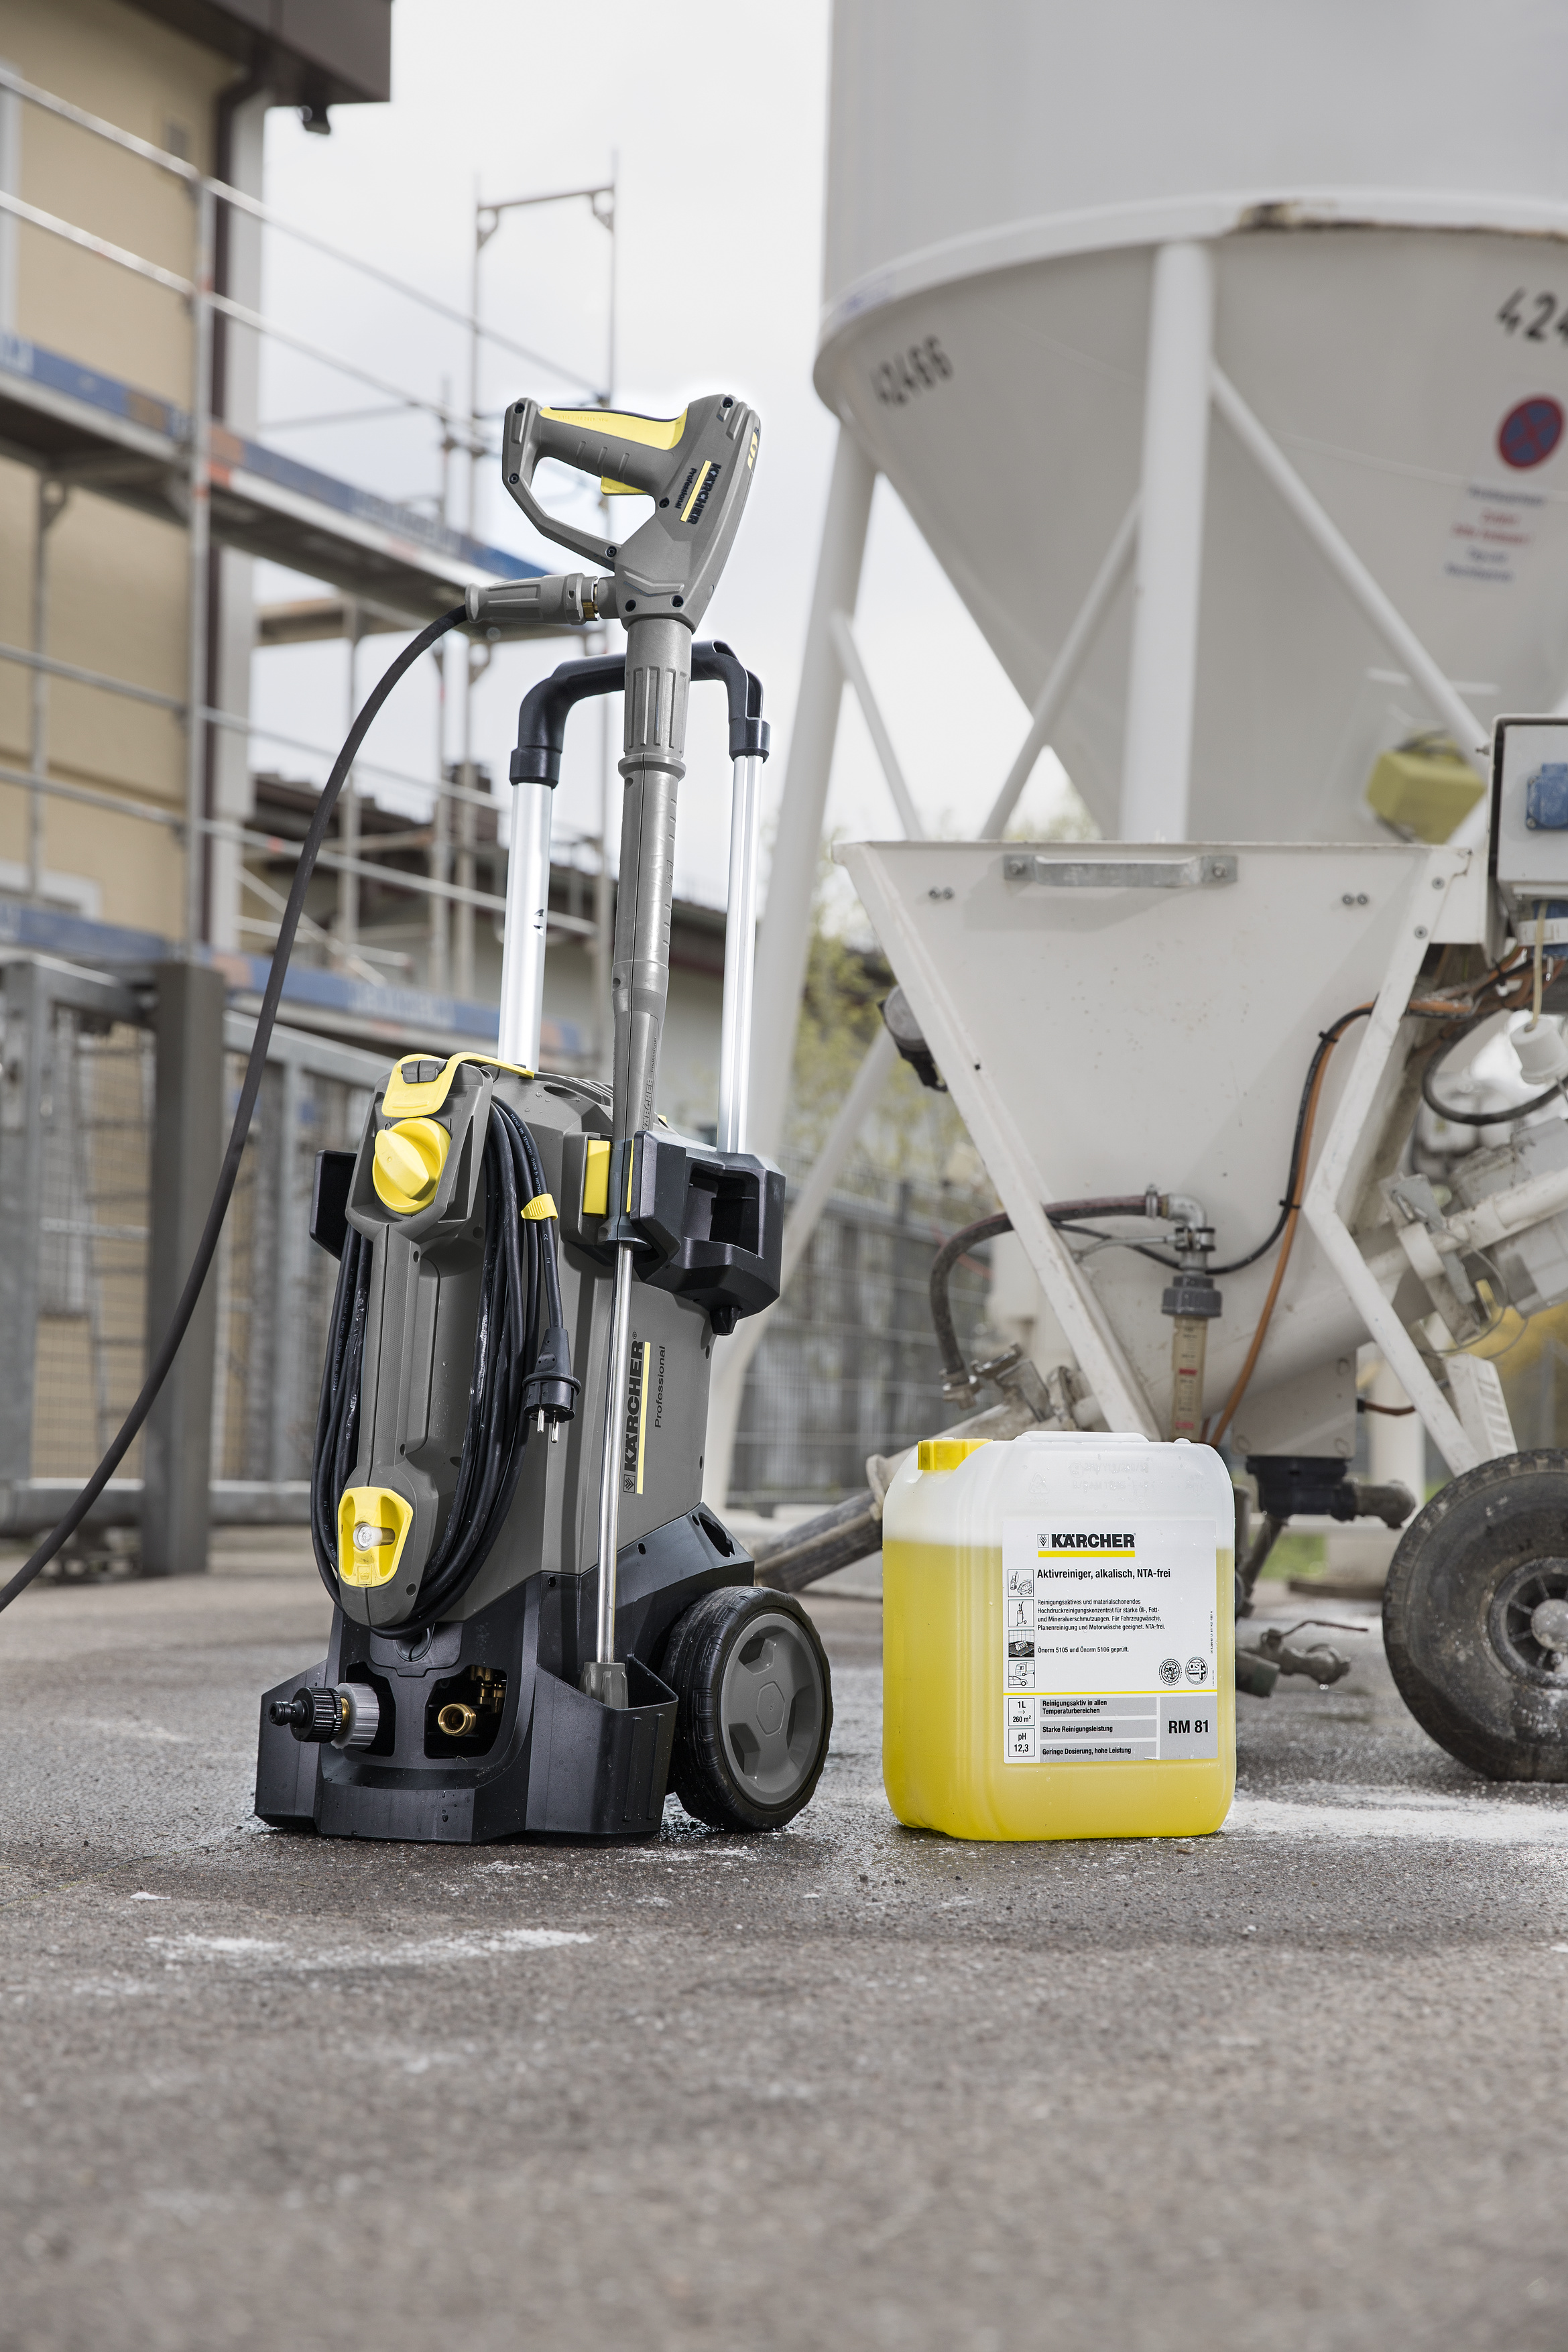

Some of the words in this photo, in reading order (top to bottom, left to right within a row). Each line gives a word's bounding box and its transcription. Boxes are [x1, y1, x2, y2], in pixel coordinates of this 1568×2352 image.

[675, 467, 697, 509] Professional
[688, 463, 721, 524] KÄRCHER
[655, 1346, 666, 1428] Professional
[625, 1341, 643, 1472] KÄRCHER
[1052, 1534, 1135, 1547] KÄRCHER
[1037, 1569, 1093, 1580] Aktivreiniger,
[1095, 1569, 1135, 1580] alkalisch,
[1137, 1568, 1170, 1578] NTA-frei
[1139, 1606, 1147, 1614] Öl-,
[1042, 1700, 1087, 1708] Reinigungsaktiv
[1062, 1725, 1113, 1734] Reinigungsleistung
[1168, 1720, 1191, 1734] RM
[1194, 1720, 1209, 1733] 81
[1018, 1733, 1026, 1742] pH
[1014, 1744, 1029, 1753] 12,3
[1042, 1748, 1063, 1756] Geringe
[1065, 1748, 1093, 1756] Dosierung,
